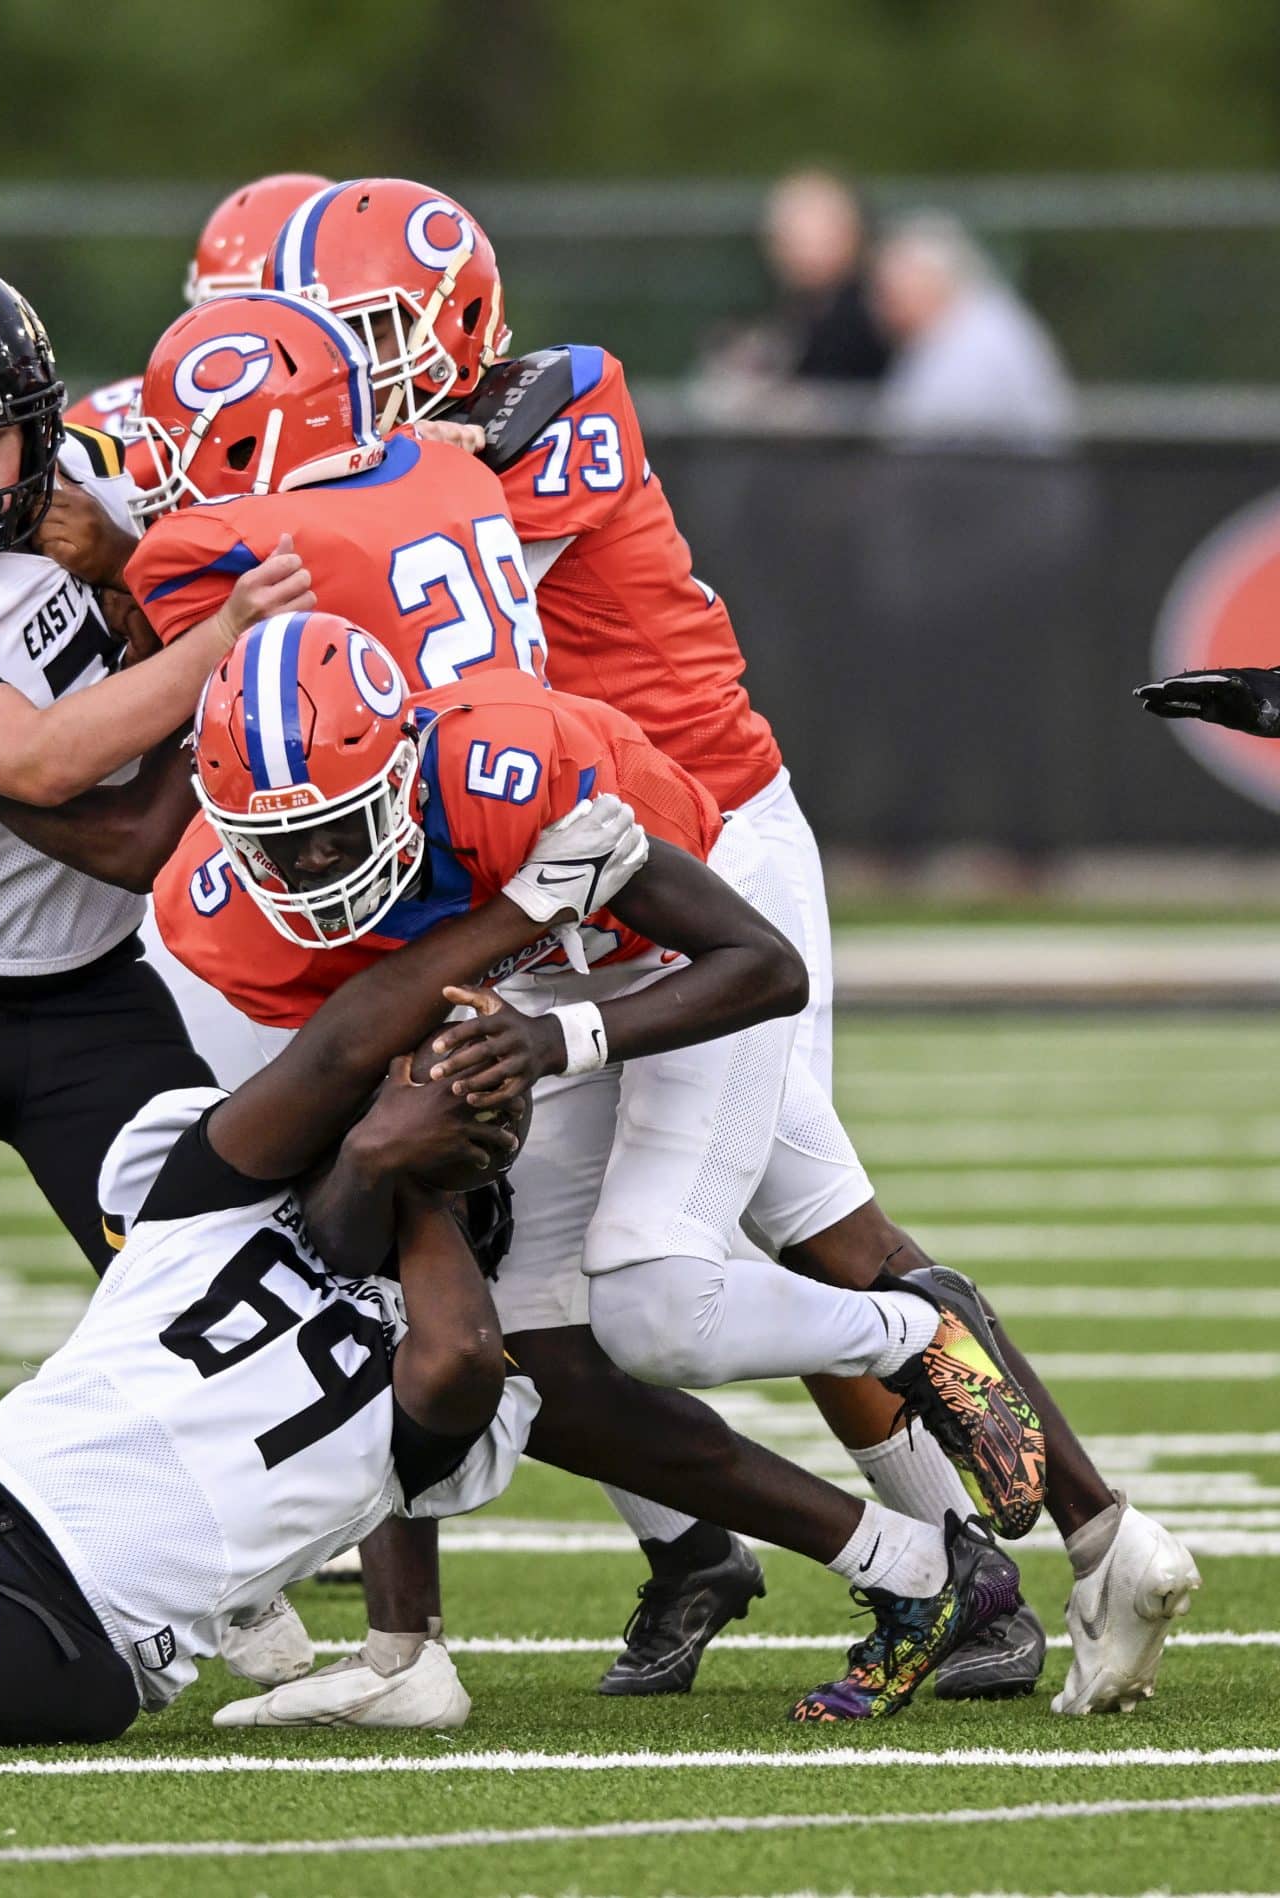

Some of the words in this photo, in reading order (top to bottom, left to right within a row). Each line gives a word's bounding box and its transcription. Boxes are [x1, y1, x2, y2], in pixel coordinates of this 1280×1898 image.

[173, 332, 273, 412] C
[528, 413, 625, 496] 73
[23, 583, 77, 661] EAST
[388, 513, 552, 690] 28
[256, 798, 287, 812] ALL
[465, 740, 543, 806] 5
[189, 847, 247, 918] 5
[159, 1226, 392, 1471] 69
[159, 1631, 173, 1662] 2XL
